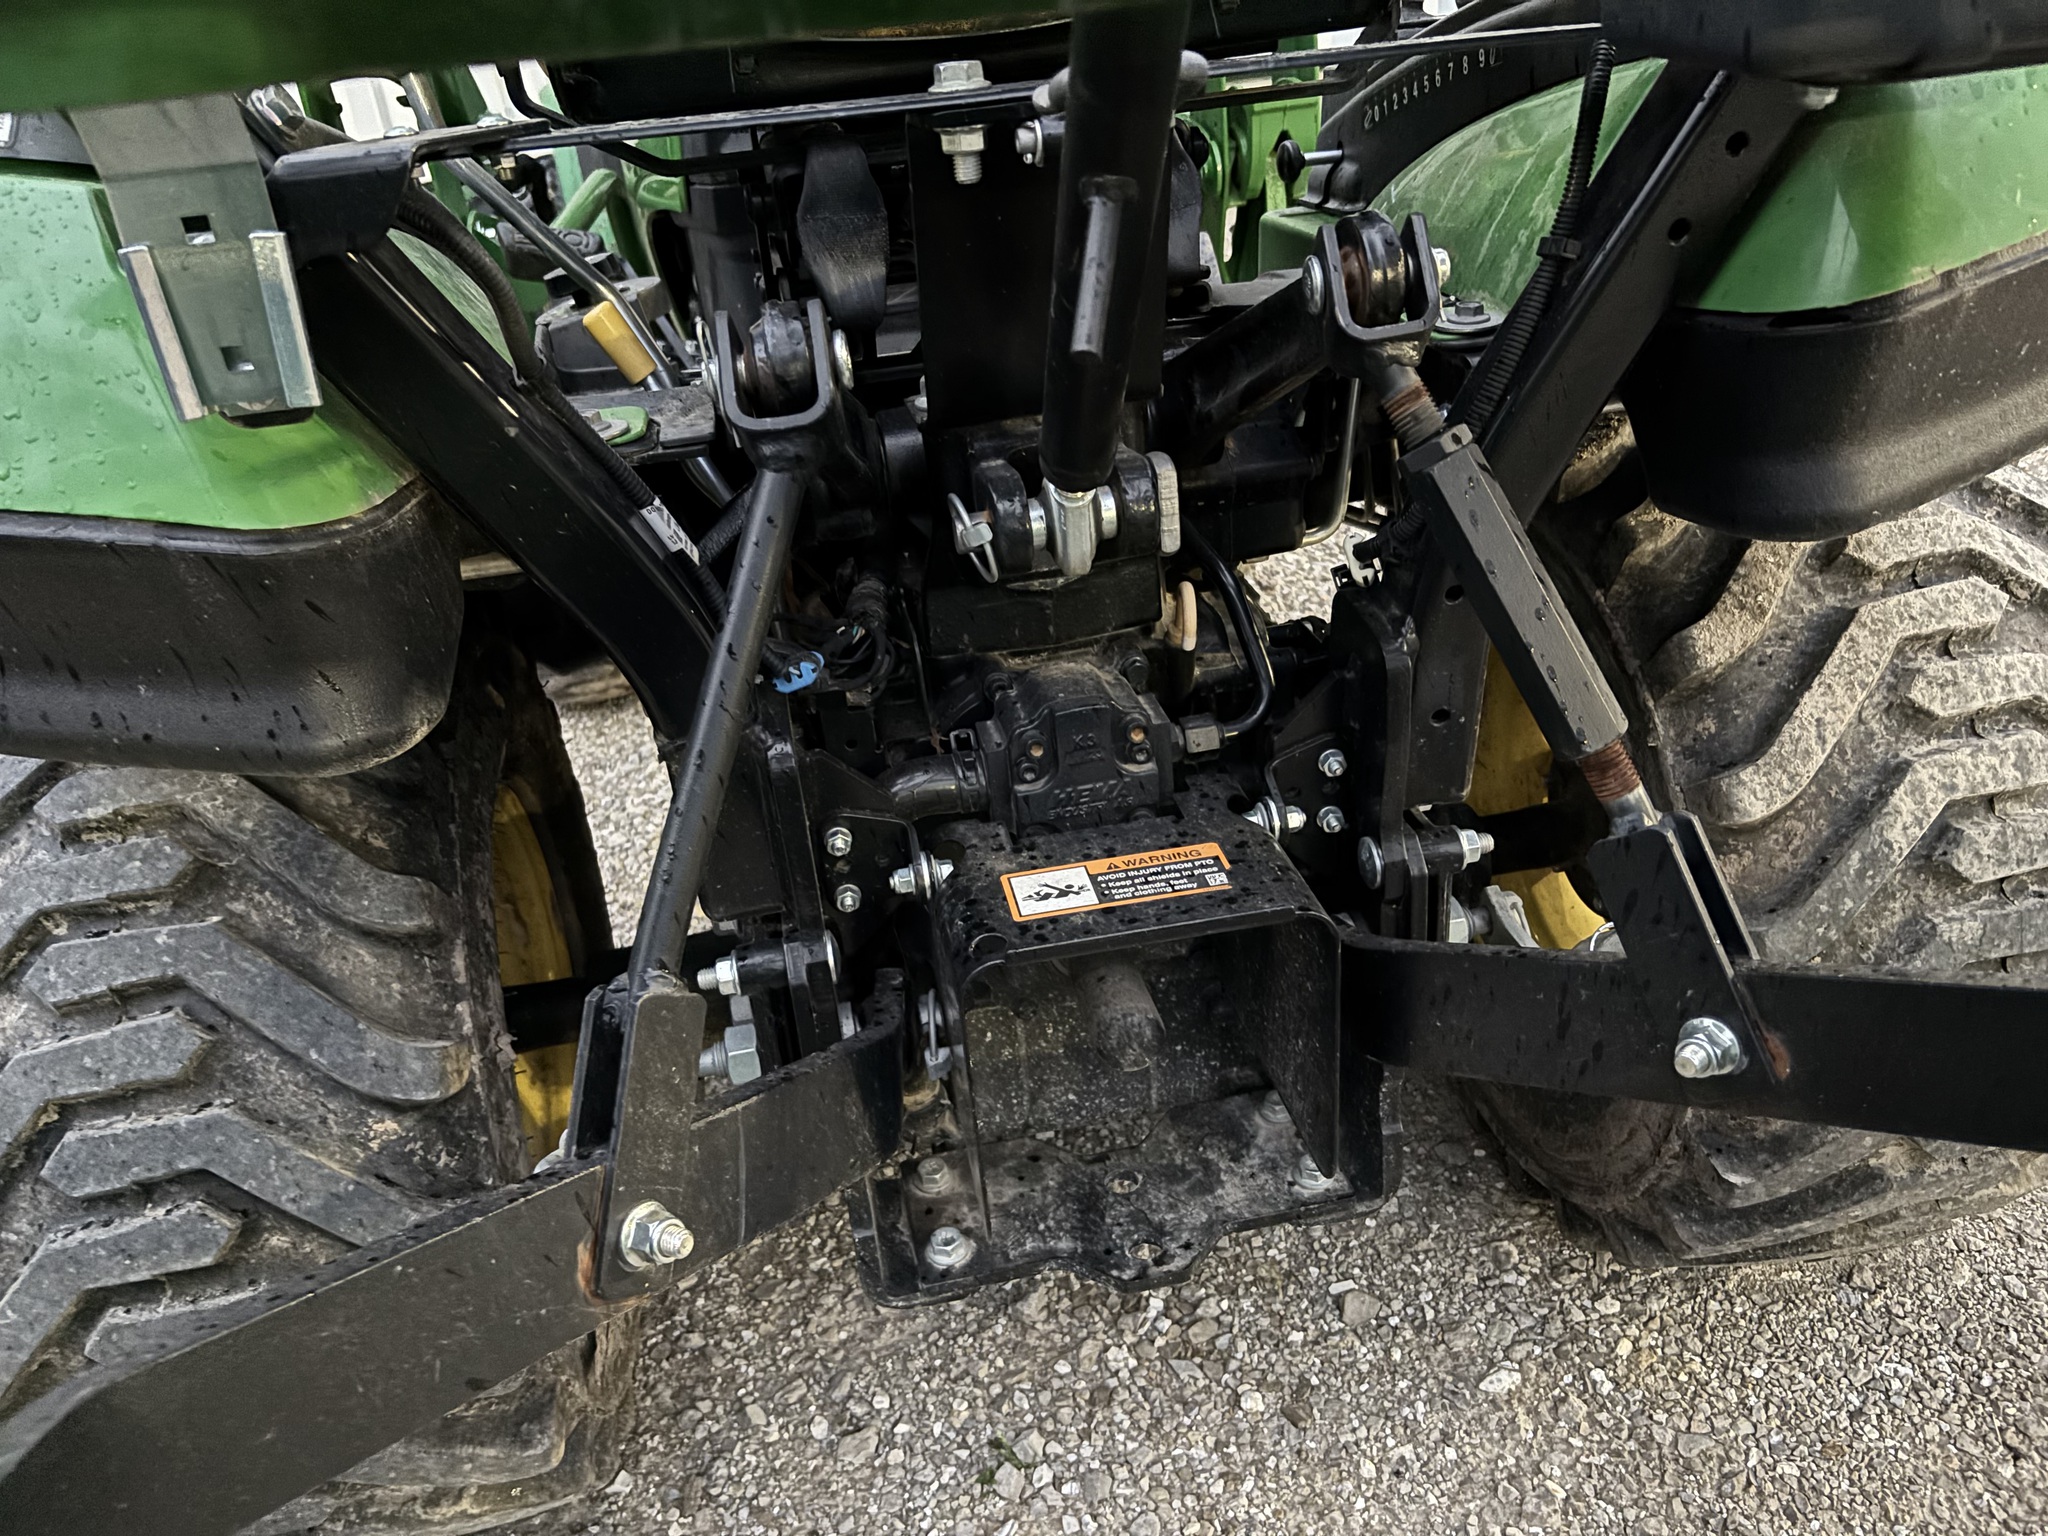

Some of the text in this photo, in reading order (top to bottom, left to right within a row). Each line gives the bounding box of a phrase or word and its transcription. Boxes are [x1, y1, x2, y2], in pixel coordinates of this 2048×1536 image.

[1374, 48, 1485, 122] 0 1 2 3 4 5 6 7 8 9
[1121, 849, 1202, 867] WARNING
[1097, 858, 1214, 882] AVOID INJURY FROM PTO
[1108, 878, 1132, 888] Keep
[1133, 876, 1146, 884] all
[1147, 872, 1181, 882] shields
[1193, 866, 1219, 875] place
[1111, 886, 1135, 896] Keep
[1170, 878, 1188, 886] feet
[1114, 892, 1133, 900] and
[1134, 887, 1173, 898] clothing
[1173, 882, 1198, 892] away
